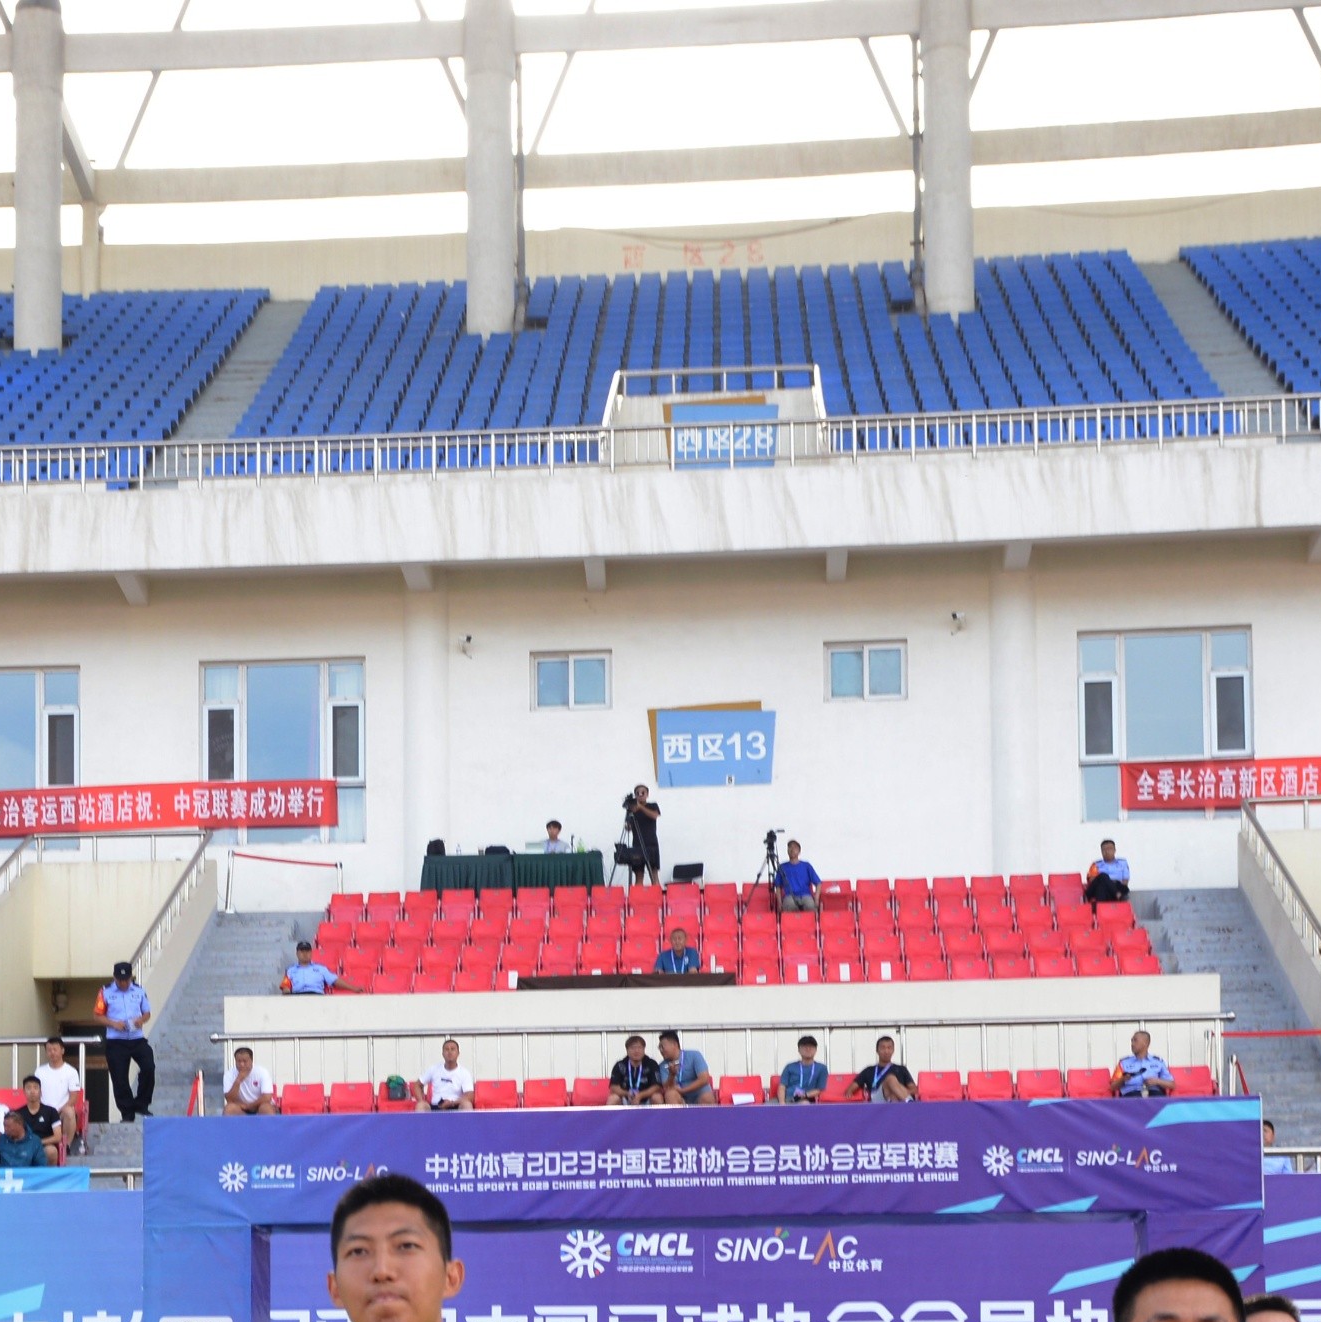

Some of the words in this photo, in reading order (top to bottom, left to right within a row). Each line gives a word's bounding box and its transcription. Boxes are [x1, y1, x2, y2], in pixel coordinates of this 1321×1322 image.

[662, 730, 767, 763] 西区13
[174, 786, 325, 820] 中冠联赛成功举行
[425, 1141, 959, 1179] 中拉体育2023中国足球协会会员协会冠军联赛
[1016, 1148, 1064, 1164] CMCL
[1076, 1146, 1163, 1168] SINO-LAC
[251, 1164, 296, 1179] CMCL
[552, 1180, 597, 1190] CHINESE
[599, 1178, 653, 1189] FOOTBALL
[655, 1177, 724, 1188] ASSOCIATION
[727, 1175, 777, 1186] MEMBER
[779, 1174, 849, 1185] ASSOCIATION
[851, 1172, 915, 1183] CHAMPIONS
[917, 1171, 959, 1182] LEAGUE
[617, 1233, 695, 1256] CMCL
[714, 1231, 859, 1265] SINO-LAC
[828, 1259, 884, 1273] 中拉体育
